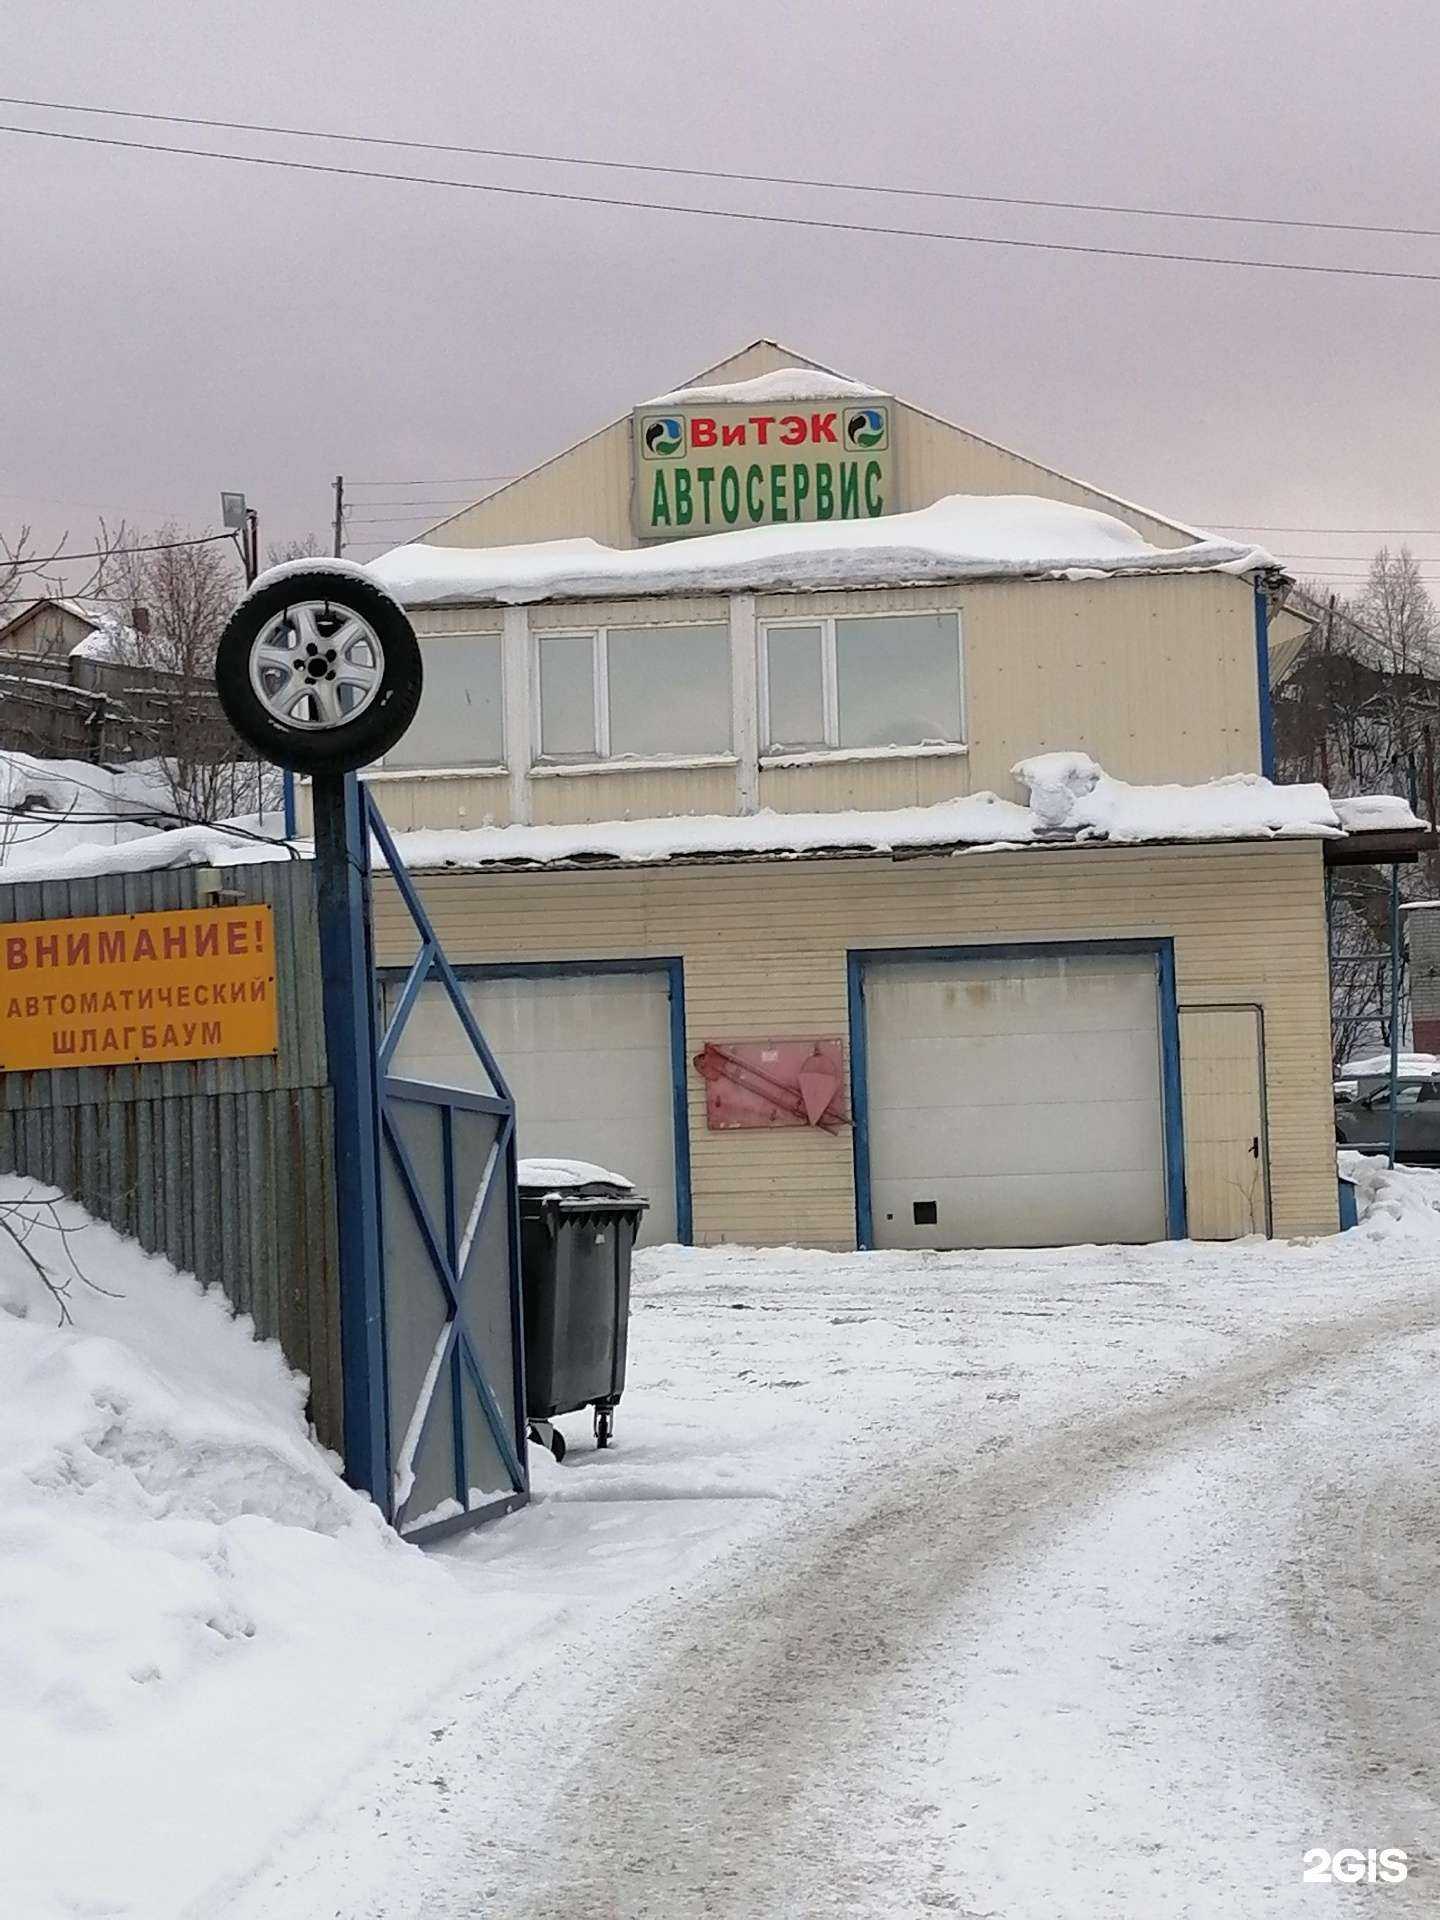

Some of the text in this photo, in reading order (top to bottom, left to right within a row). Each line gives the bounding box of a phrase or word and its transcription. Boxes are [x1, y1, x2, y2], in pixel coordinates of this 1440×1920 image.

[690, 413, 838, 447] ВиТЭК
[651, 460, 884, 526] АВТОСЕРВИС
[6, 920, 264, 970] ВНИМАНИЕ!
[7, 976, 266, 1018] АВТОМАТИЧЕСКИЙ
[53, 1021, 222, 1054] ШЛАГБАУМ
